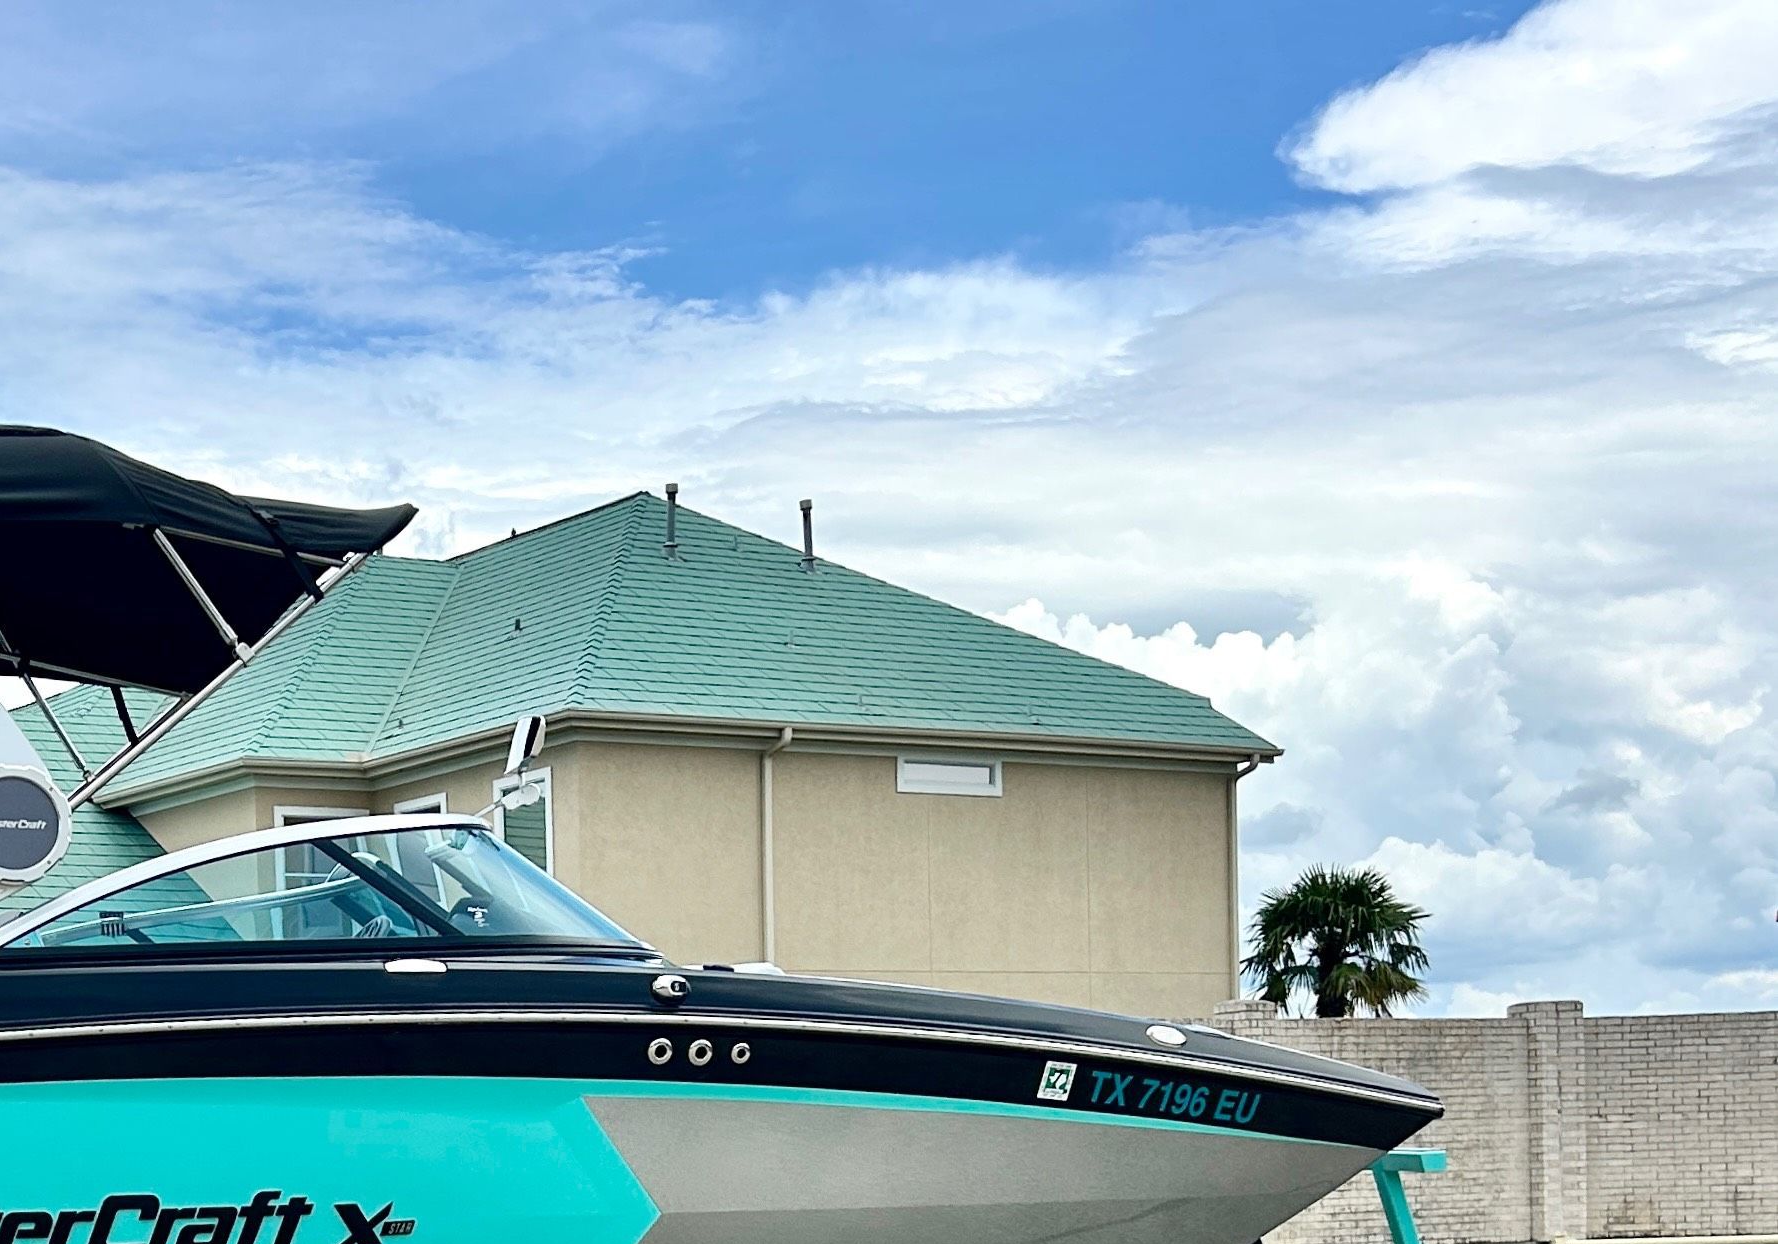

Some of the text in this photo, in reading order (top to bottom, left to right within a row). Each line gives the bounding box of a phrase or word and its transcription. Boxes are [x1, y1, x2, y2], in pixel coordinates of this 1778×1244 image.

[1091, 1071, 1133, 1106] TX
[1138, 1079, 1209, 1117] 7196
[1214, 1090, 1261, 1123] EU
[388, 1222, 413, 1235] STAR
